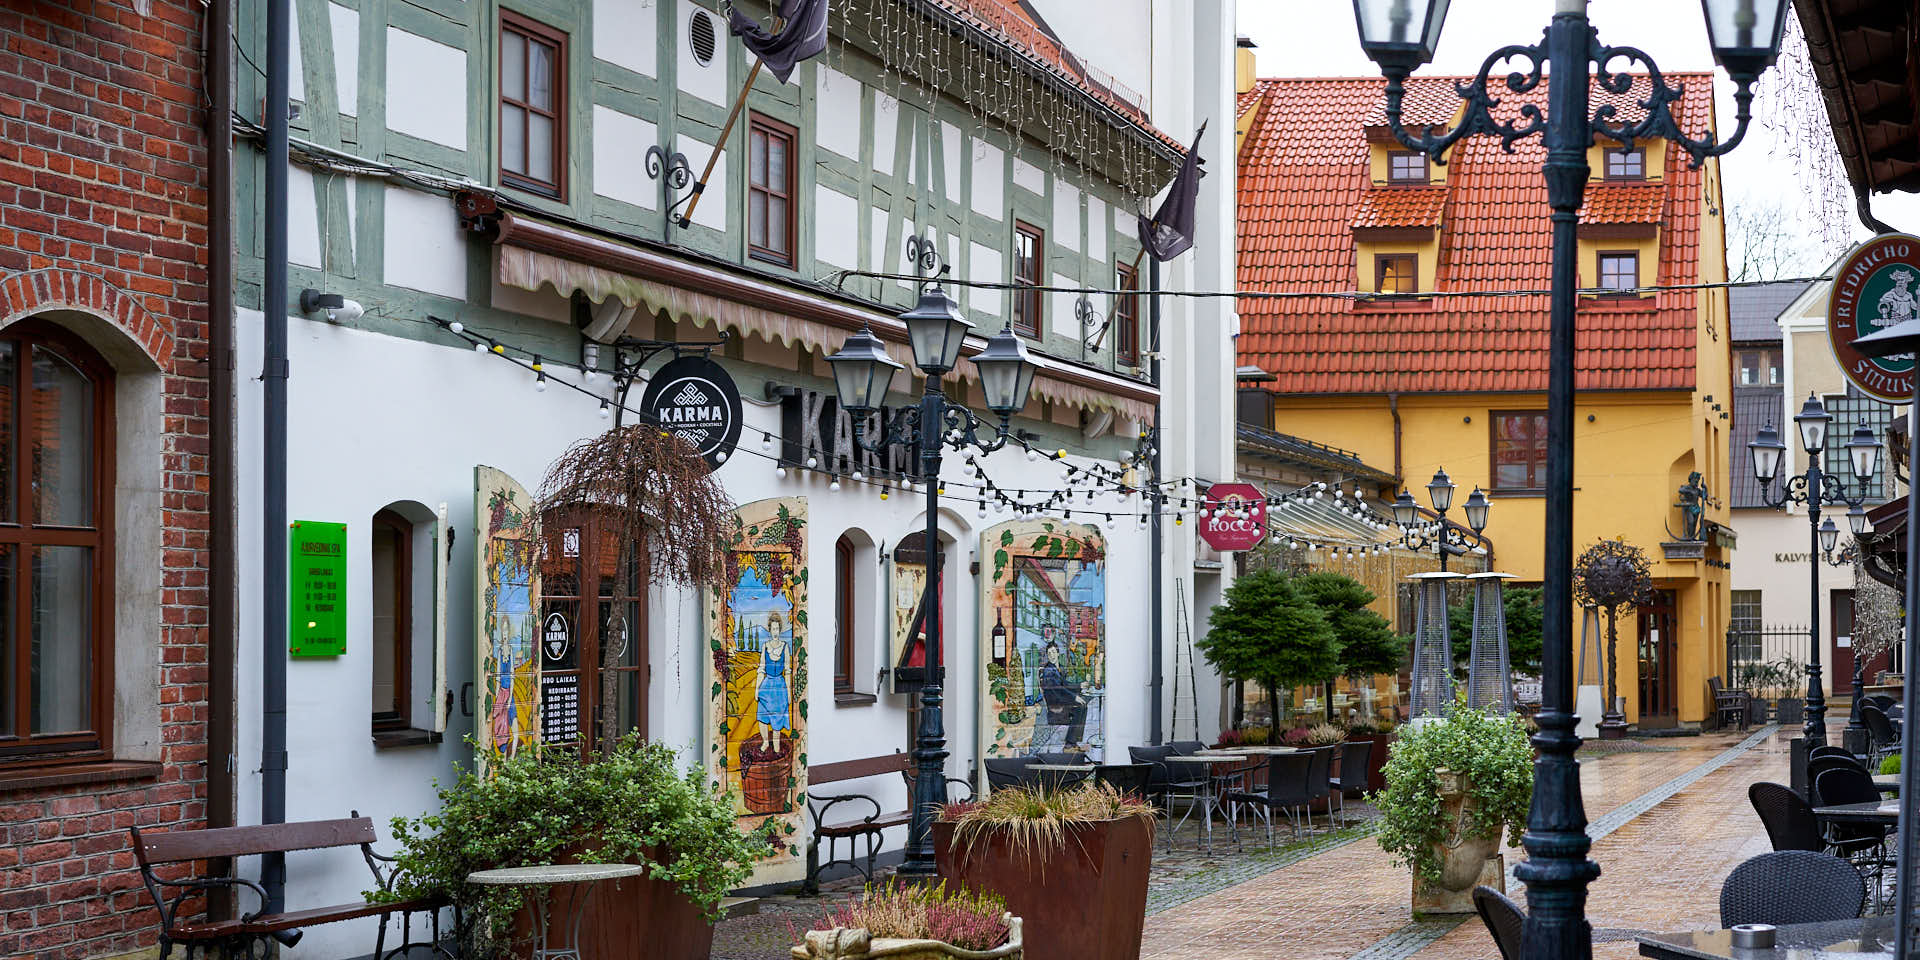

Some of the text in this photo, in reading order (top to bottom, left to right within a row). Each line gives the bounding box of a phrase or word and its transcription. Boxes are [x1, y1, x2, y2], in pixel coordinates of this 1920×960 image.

[1837, 244, 1909, 328] FRIEDRICHO
[1853, 360, 1914, 392] SMUK
[660, 406, 722, 422] KARMA
[801, 390, 925, 480] KARM
[1208, 520, 1257, 532] ROCCA
[546, 631, 566, 641] KARMA
[556, 675, 577, 683] LAIKAS
